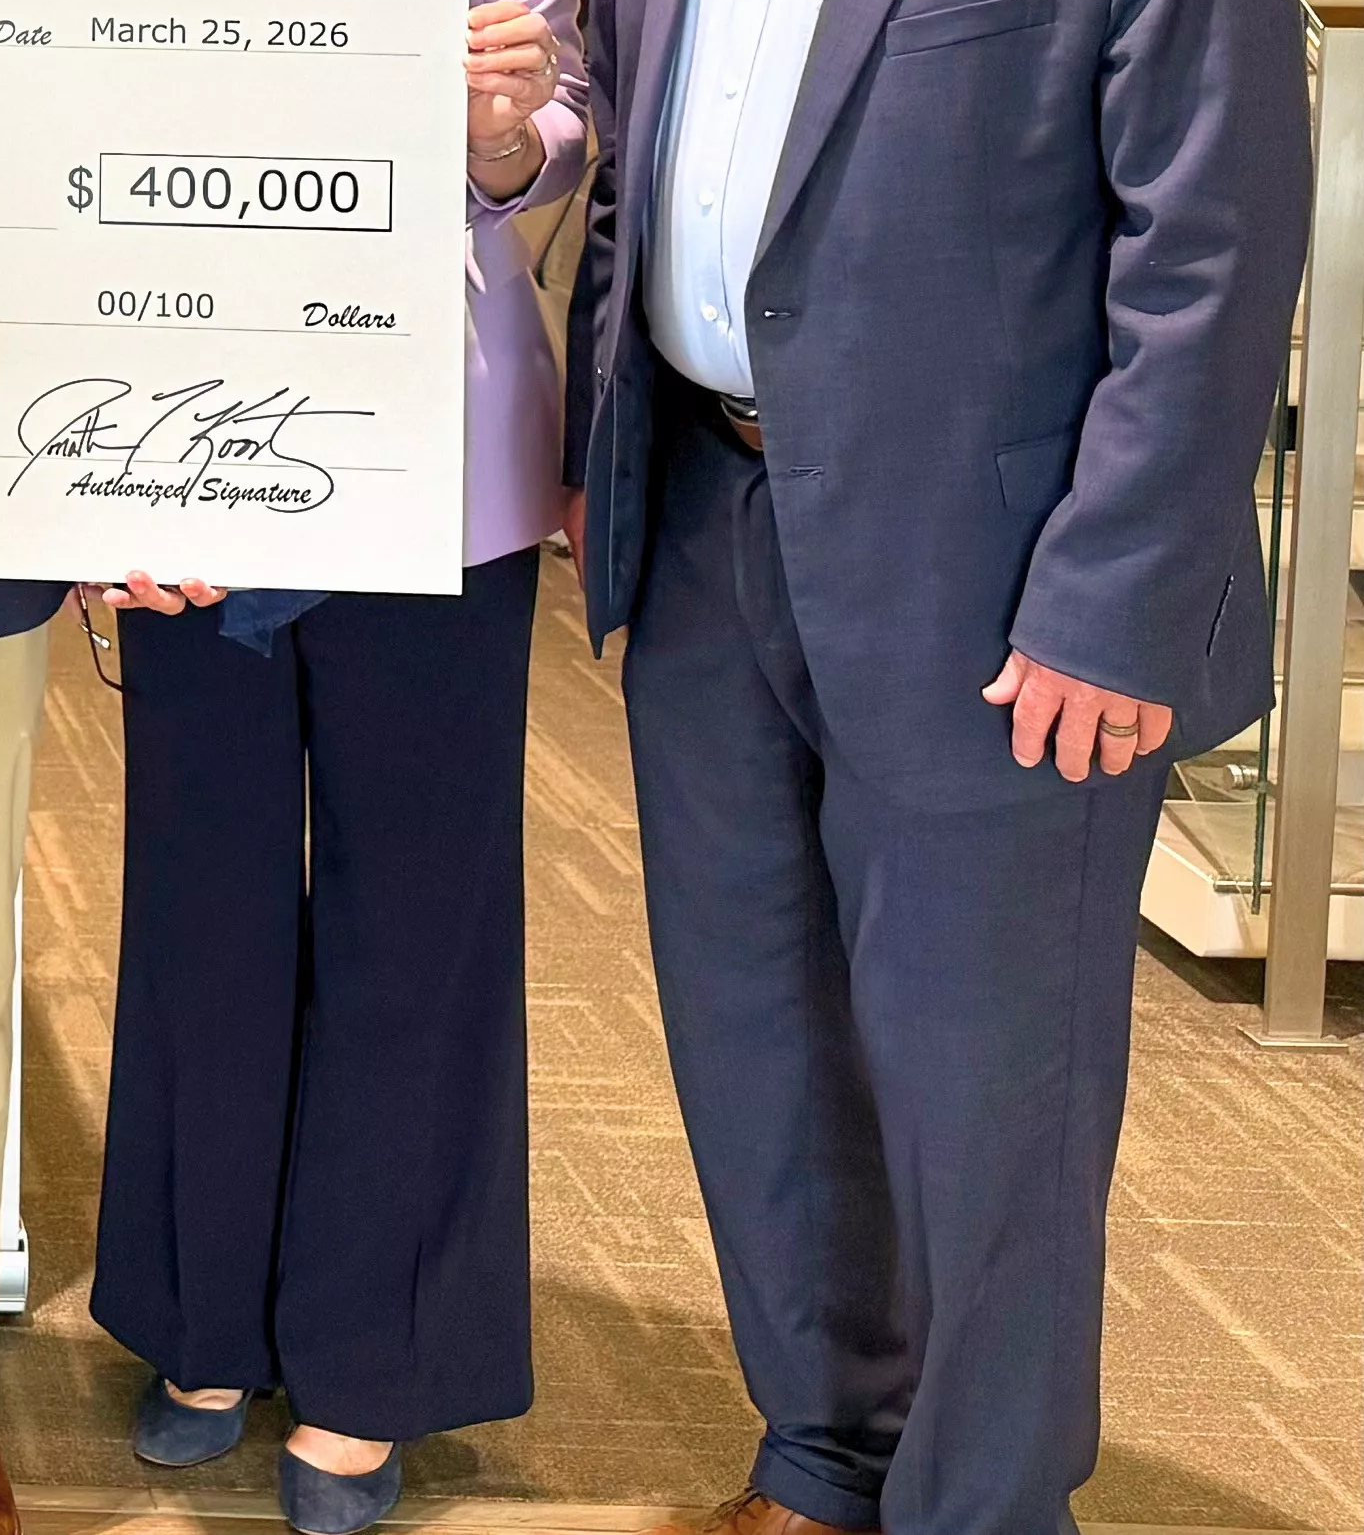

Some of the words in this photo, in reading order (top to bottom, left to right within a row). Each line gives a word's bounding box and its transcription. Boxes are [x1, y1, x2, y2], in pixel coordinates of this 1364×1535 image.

[91, 16, 186, 44] March
[201, 19, 252, 51] 25,
[267, 20, 349, 48] 2026
[66, 164, 94, 214] $
[128, 165, 361, 220] 400,000
[97, 290, 214, 322] 00/100
[302, 301, 397, 330] Dollars
[66, 471, 188, 508] Authorized
[198, 477, 313, 509] Signature
